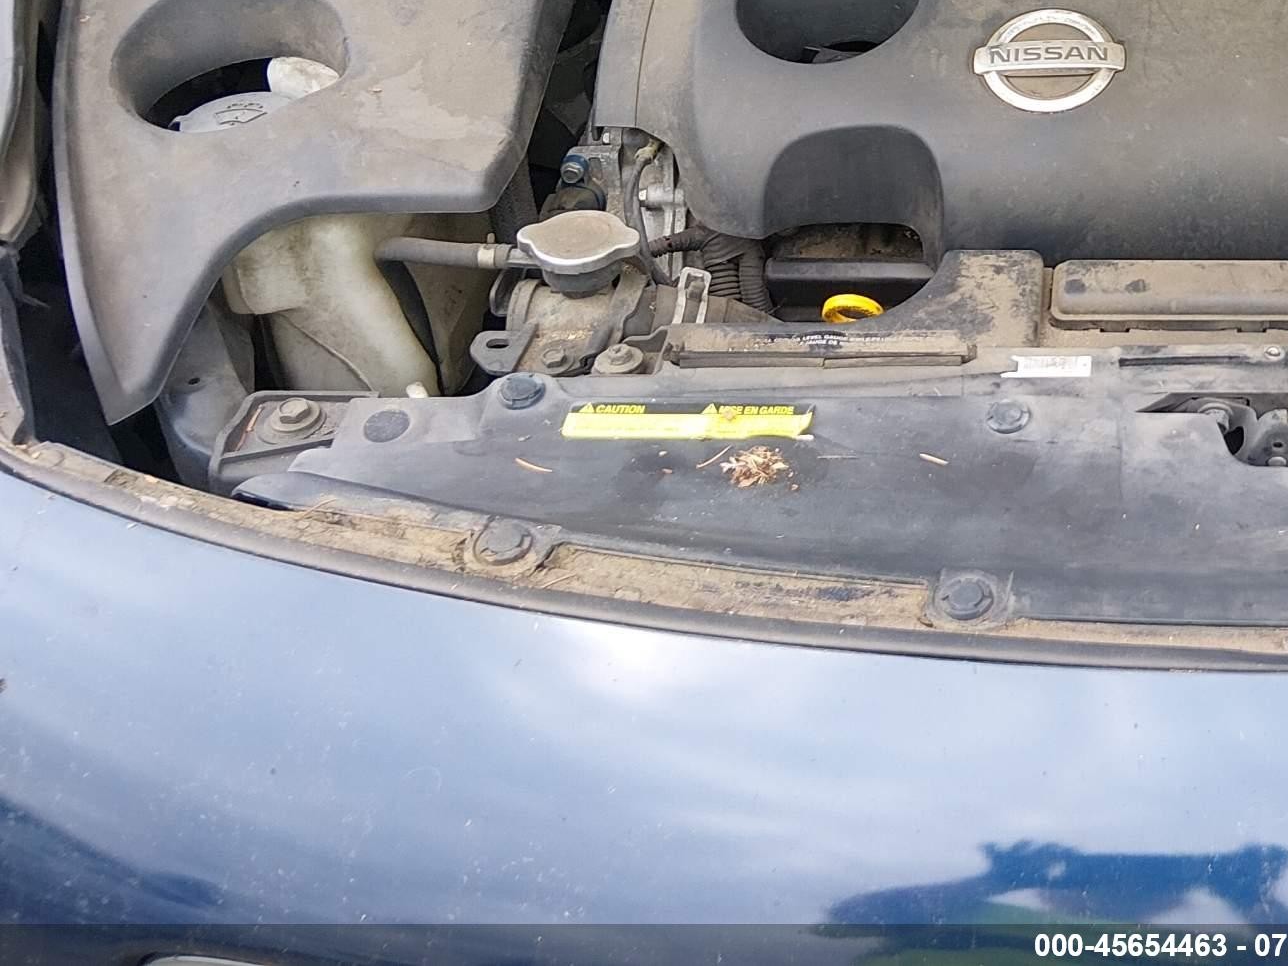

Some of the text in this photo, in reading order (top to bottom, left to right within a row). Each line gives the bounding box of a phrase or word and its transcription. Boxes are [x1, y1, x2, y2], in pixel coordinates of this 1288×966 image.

[988, 45, 1109, 64] NISSAN
[595, 404, 646, 414] CAUTION
[744, 405, 760, 414] EN
[760, 406, 794, 415] GARDE
